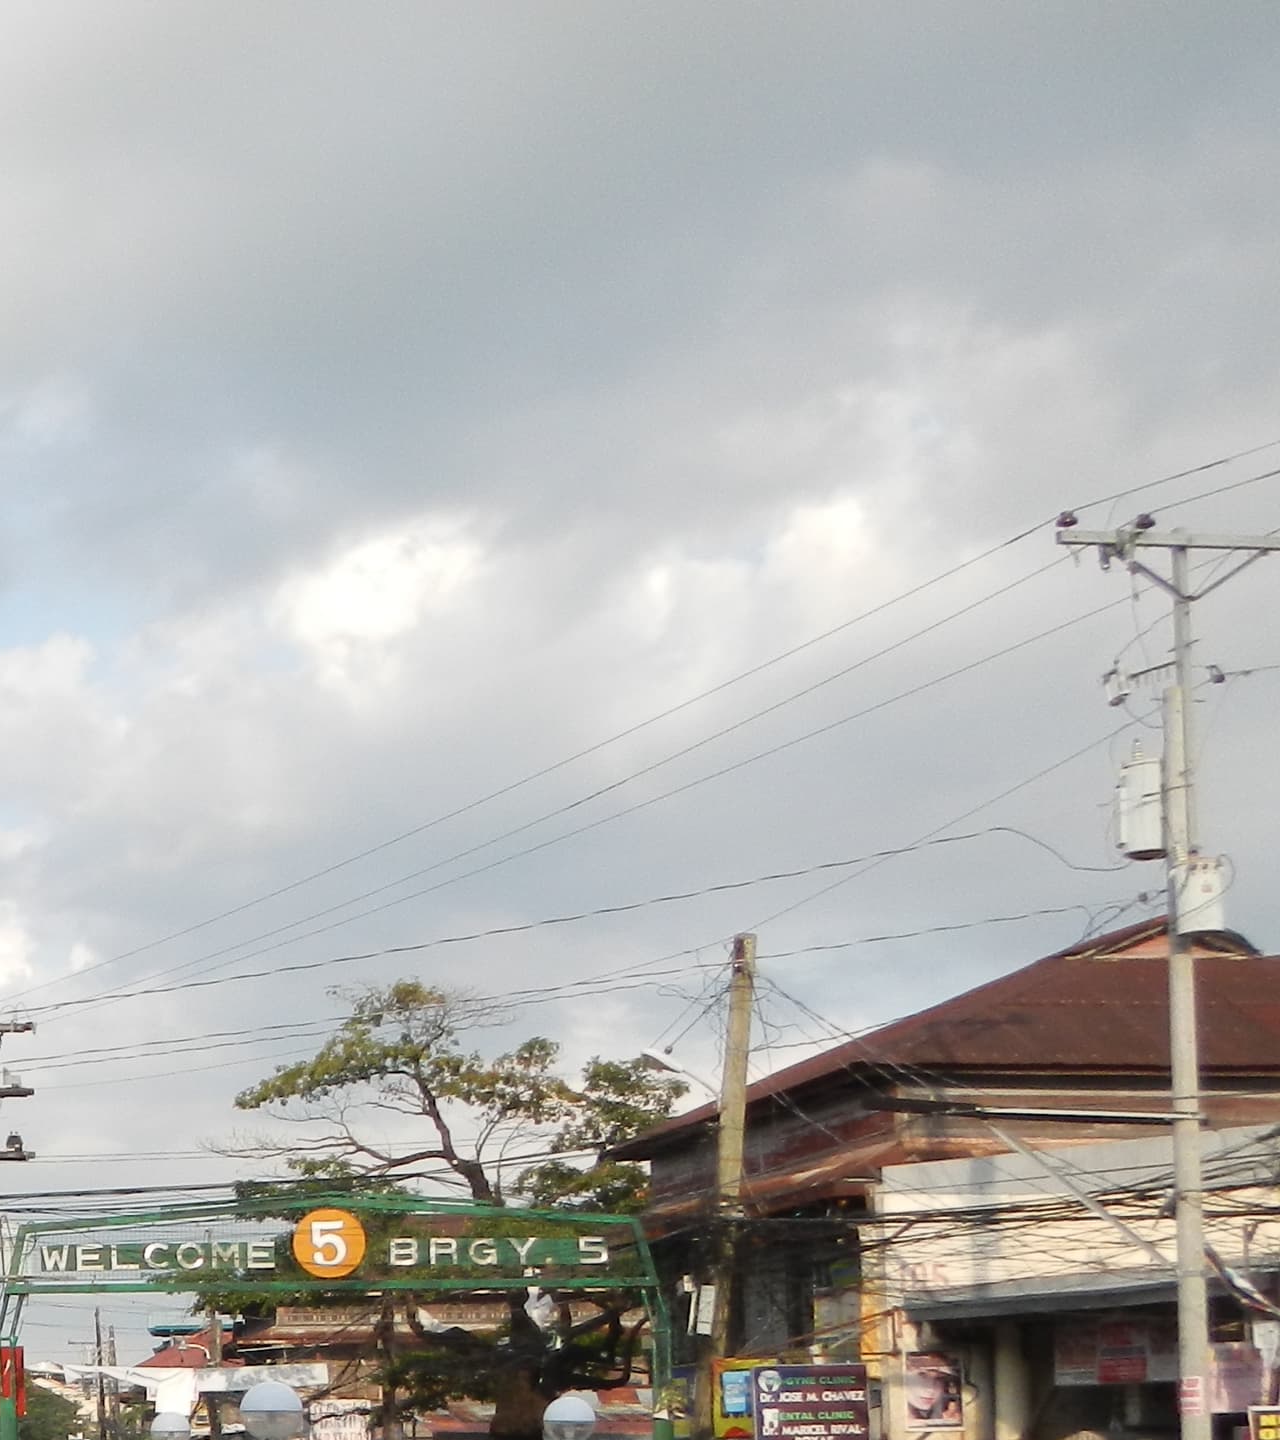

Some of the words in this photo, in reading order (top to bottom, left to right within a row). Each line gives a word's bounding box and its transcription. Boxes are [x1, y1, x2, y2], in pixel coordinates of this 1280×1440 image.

[41, 1241, 276, 1272] WELCOME
[310, 1220, 347, 1267] 5
[577, 1235, 610, 1265] 5
[759, 1391, 775, 1403] Dr.
[779, 1391, 803, 1402] JOSE
[821, 1390, 865, 1401] CHAVEZ
